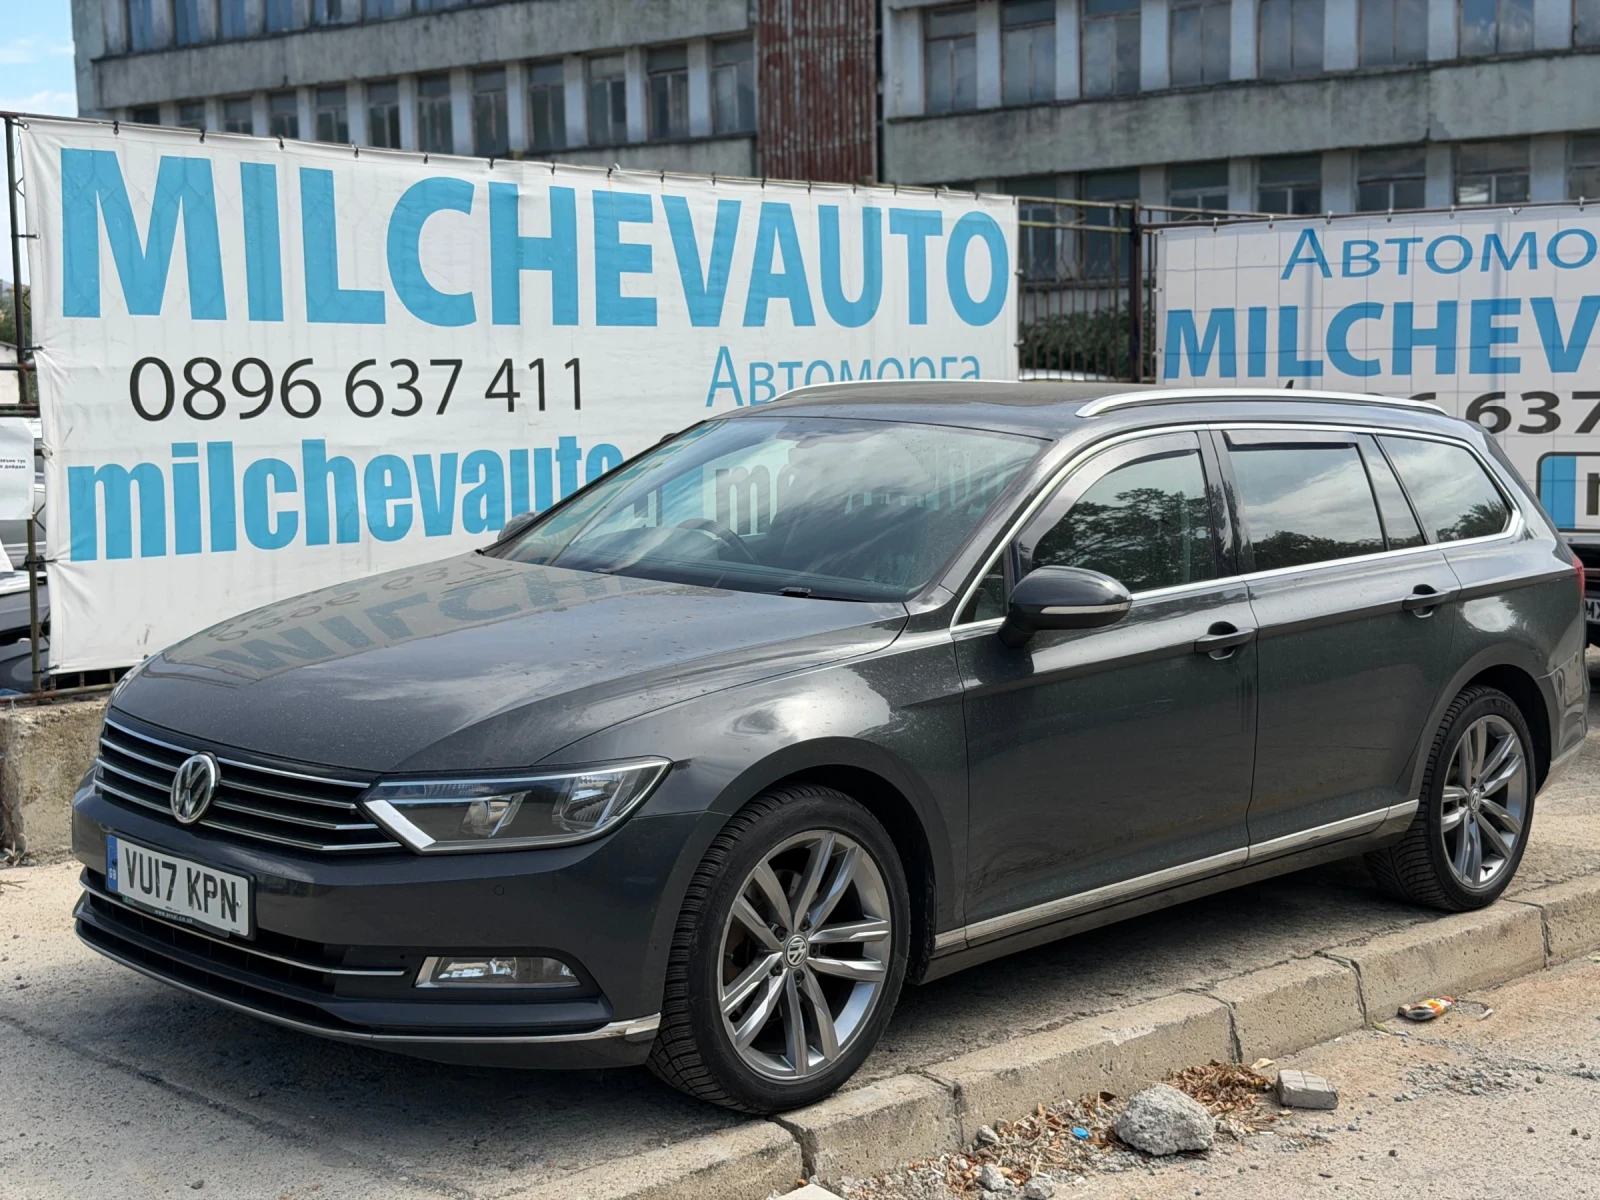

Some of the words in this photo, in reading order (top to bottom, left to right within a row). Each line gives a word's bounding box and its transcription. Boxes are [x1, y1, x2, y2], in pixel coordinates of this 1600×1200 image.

[61, 147, 1009, 328] MILCHEVAUTO
[1163, 295, 1600, 379] MILCHEV
[130, 356, 322, 422] 0896
[345, 358, 463, 418] 637
[484, 357, 581, 413] 411
[1465, 390, 1600, 435] 637
[125, 848, 177, 902] VU17
[186, 866, 238, 923] KPN
